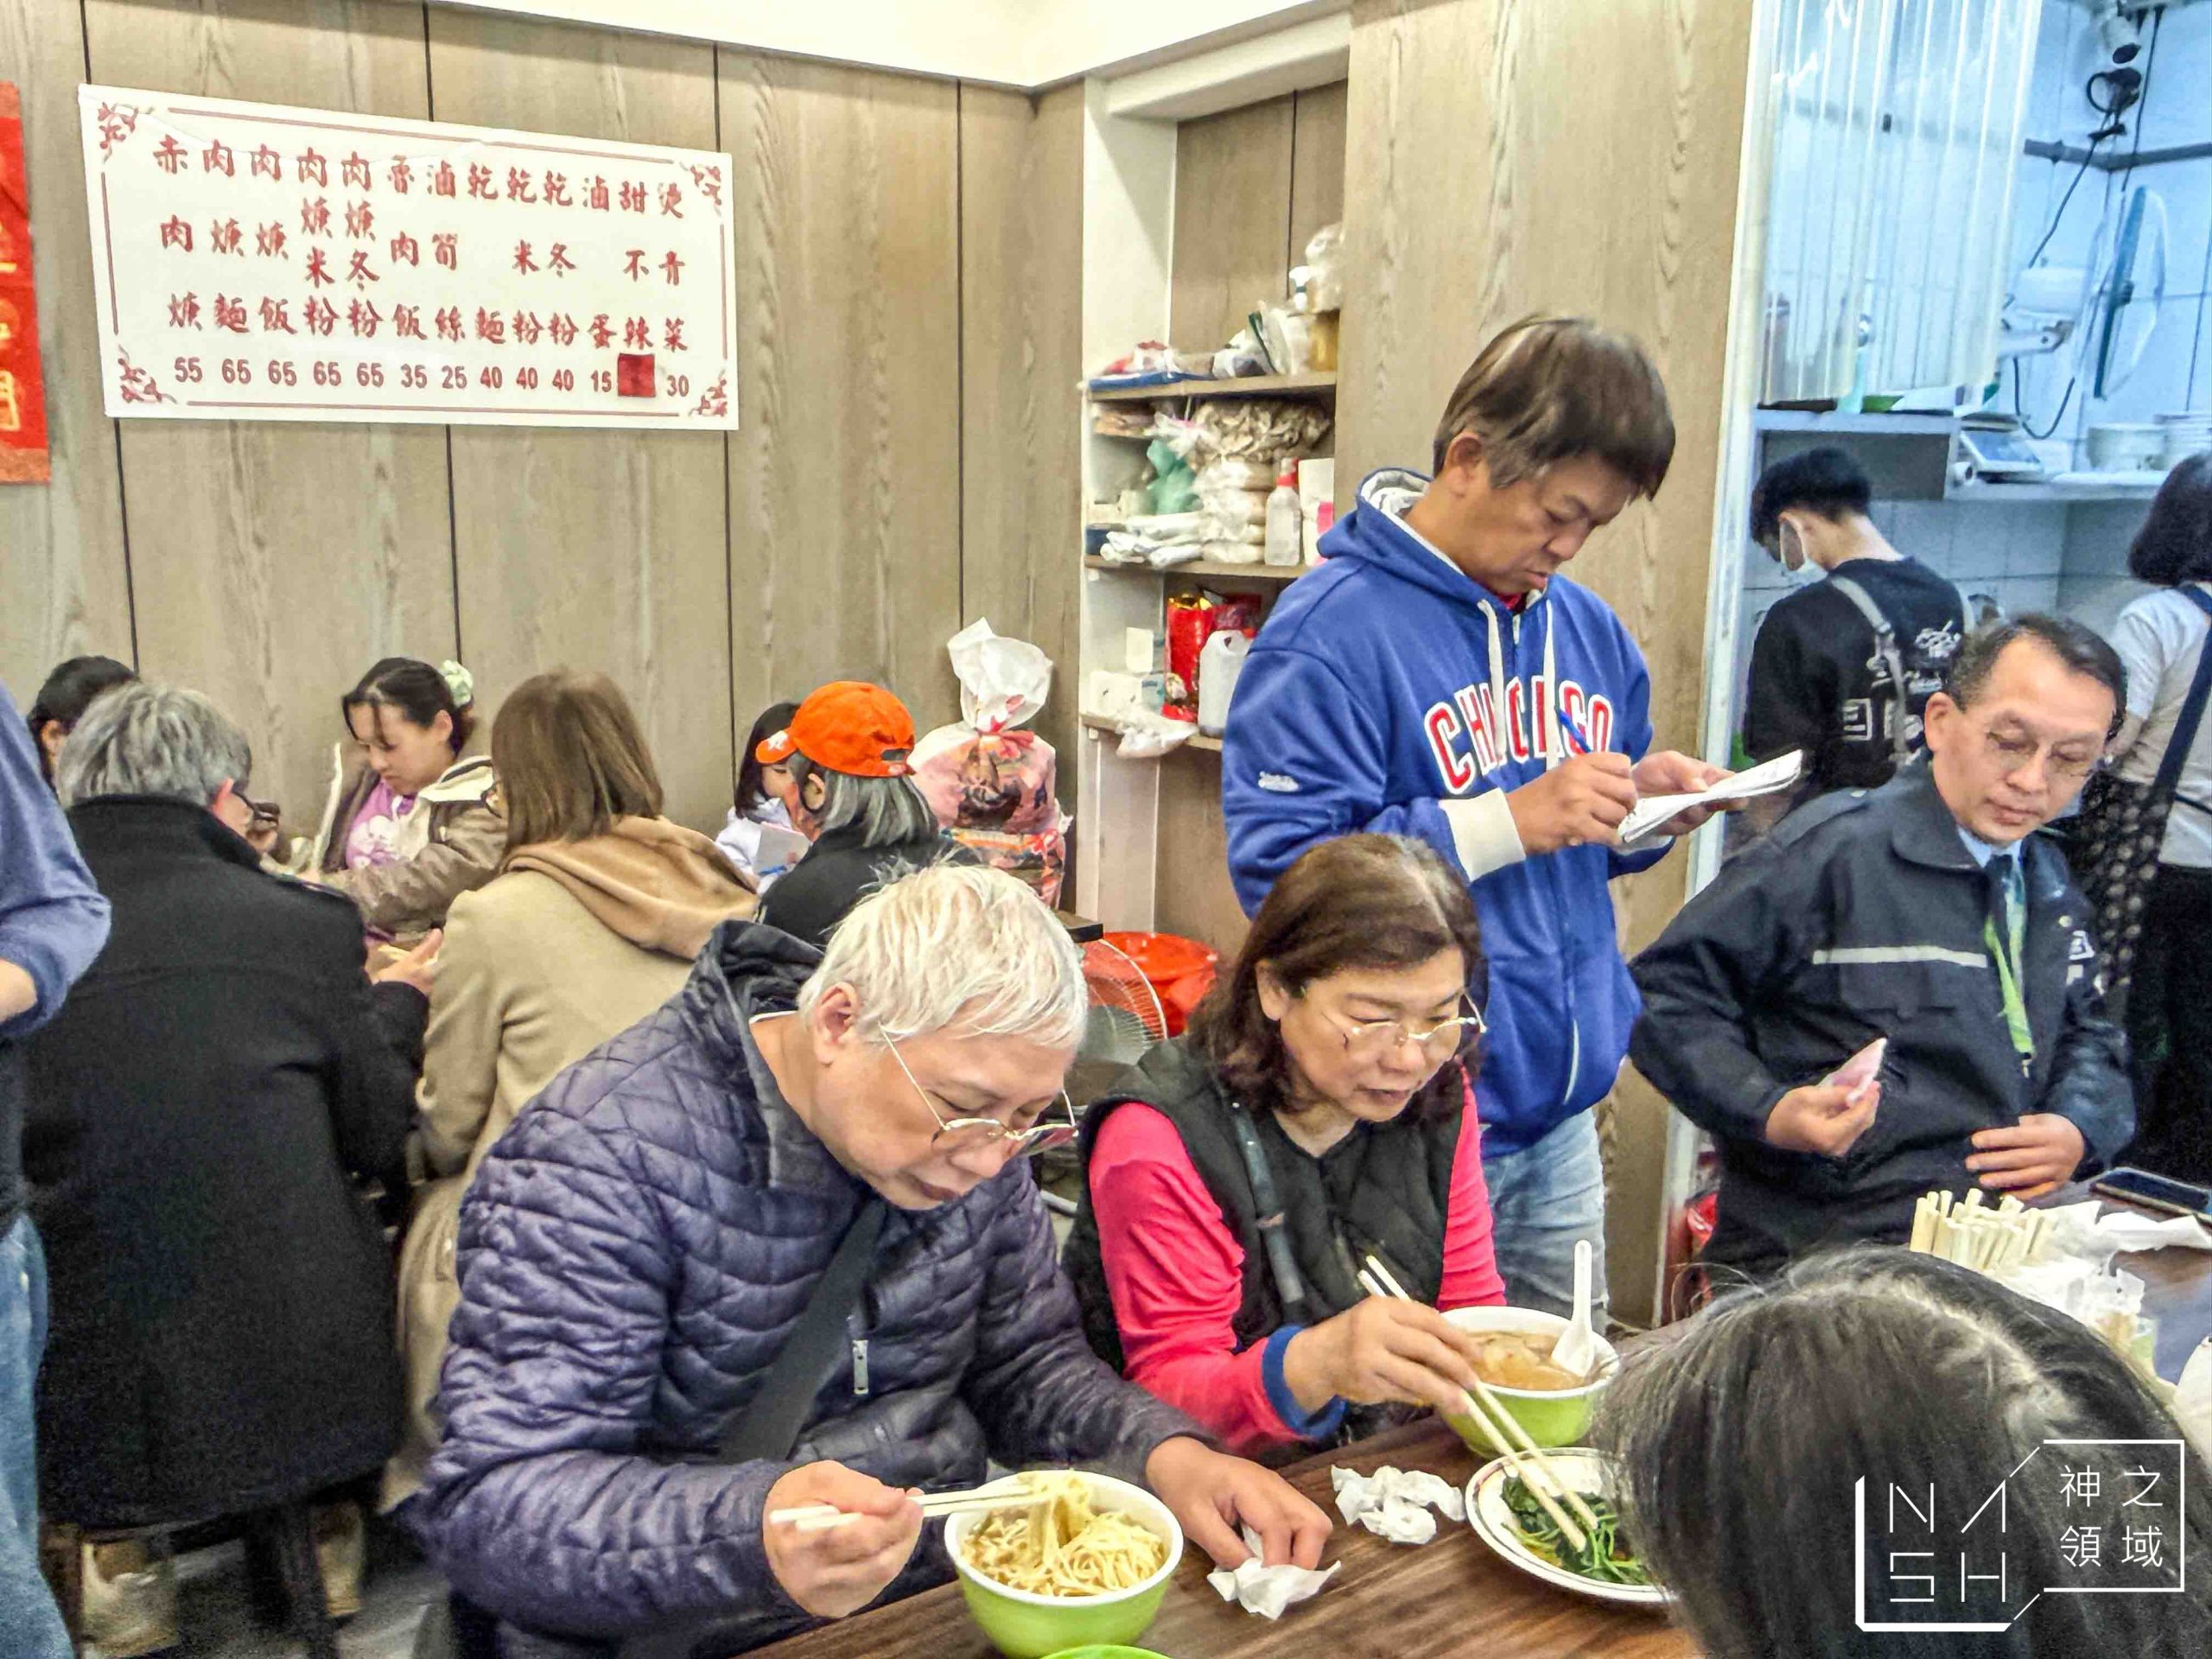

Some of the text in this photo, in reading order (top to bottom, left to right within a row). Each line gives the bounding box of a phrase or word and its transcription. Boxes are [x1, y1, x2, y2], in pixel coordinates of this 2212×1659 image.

[619, 181, 653, 350] 甜不辣
[174, 357, 203, 383] 55
[221, 359, 251, 384] 65
[268, 359, 297, 386] 65
[313, 360, 341, 386] 65
[357, 362, 384, 387] 65
[400, 364, 427, 388] 35
[442, 365, 467, 389] 25
[480, 366, 503, 389] 40
[516, 366, 538, 390] 40
[552, 369, 574, 391] 40
[591, 370, 612, 392] 15
[666, 375, 690, 397] 30
